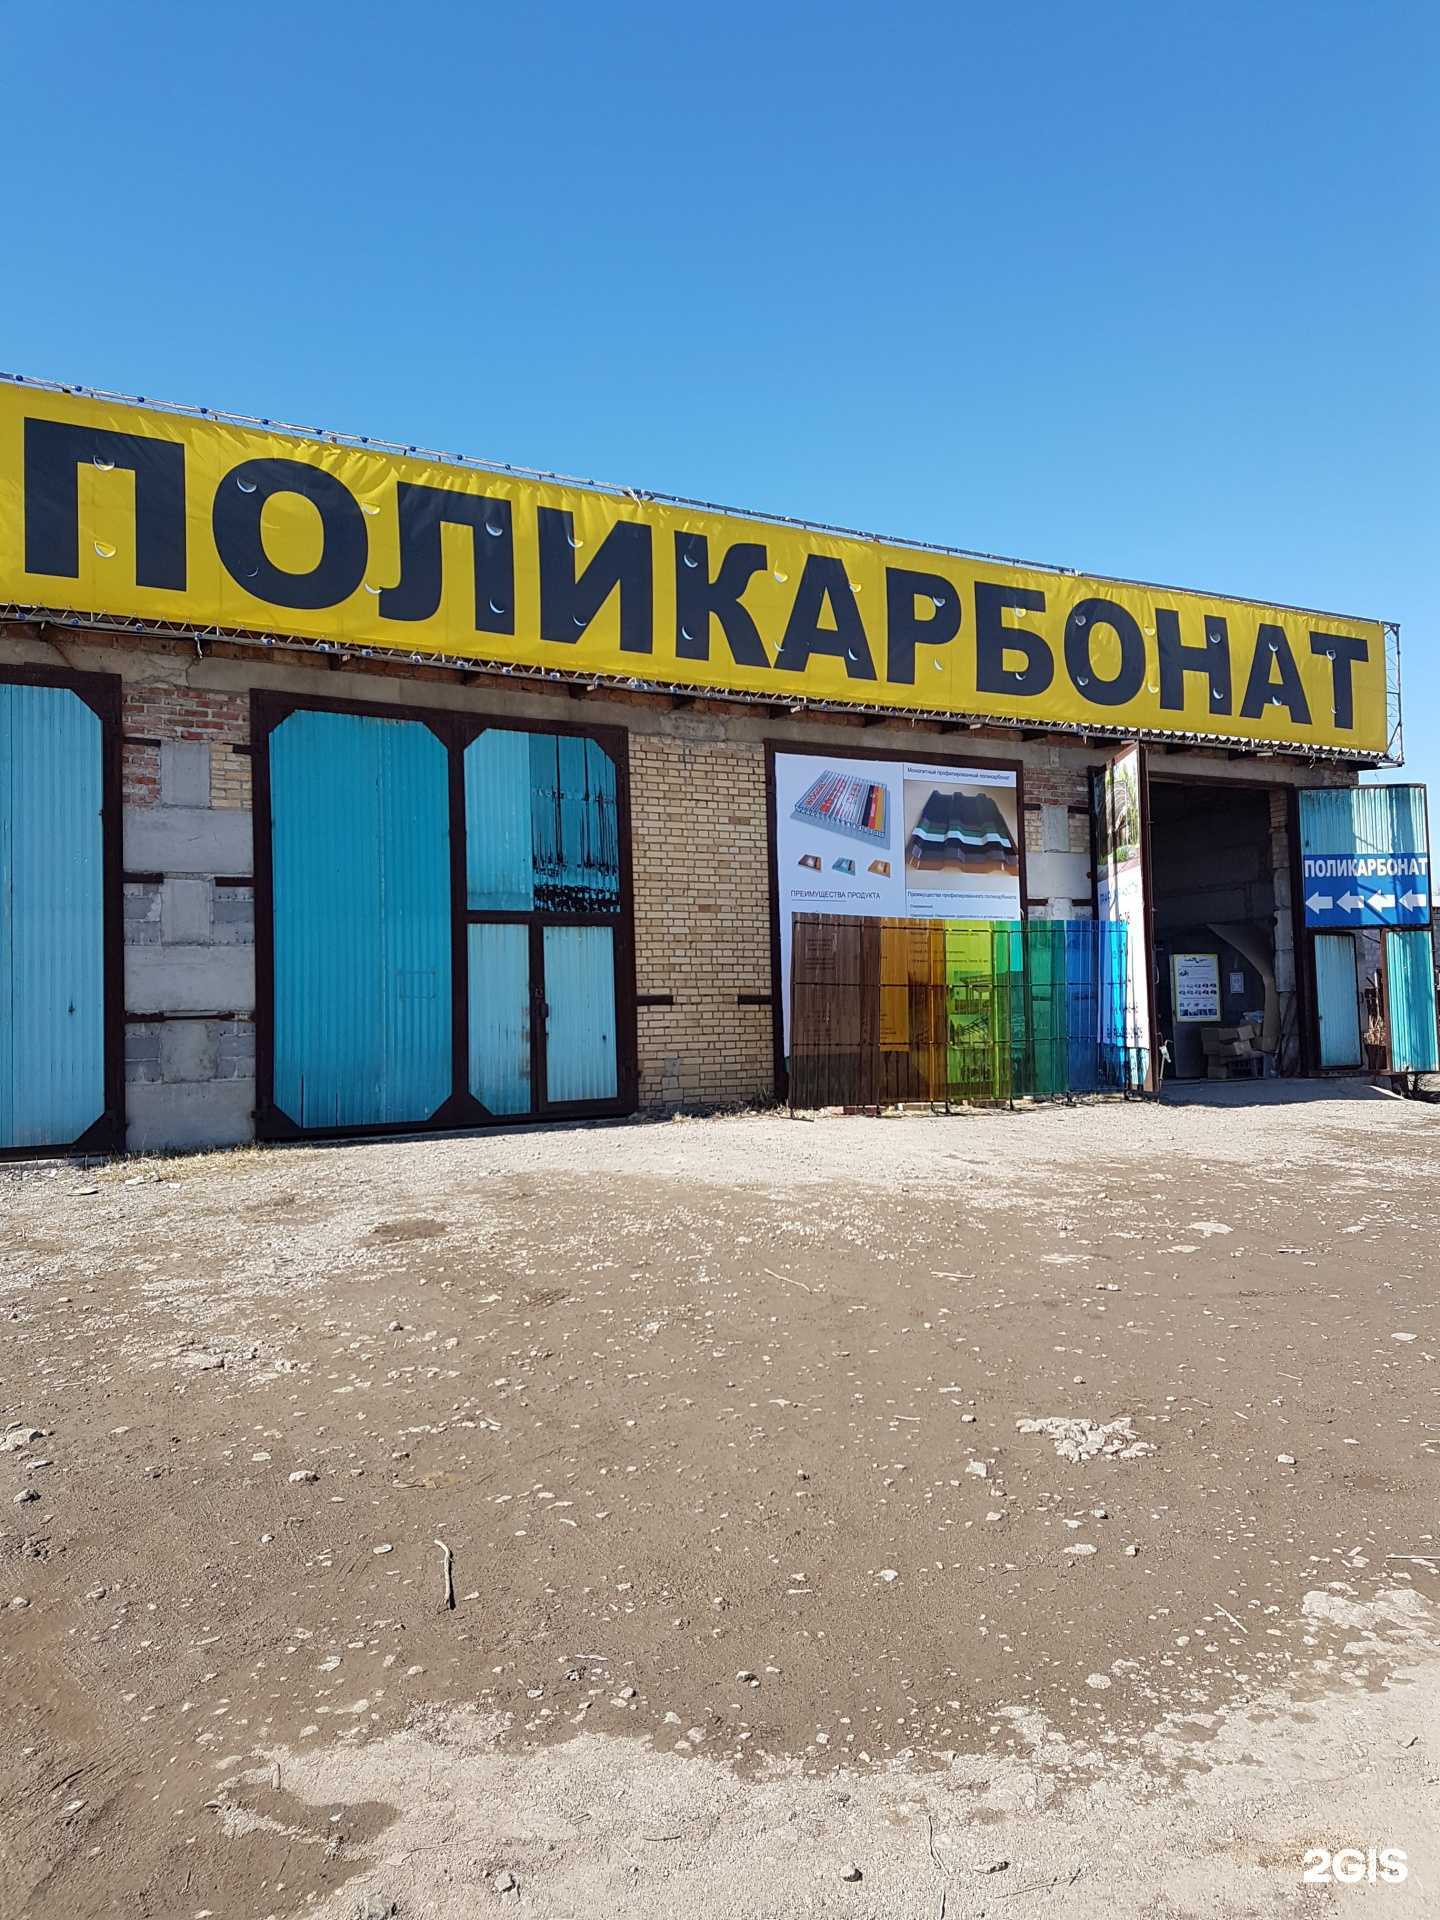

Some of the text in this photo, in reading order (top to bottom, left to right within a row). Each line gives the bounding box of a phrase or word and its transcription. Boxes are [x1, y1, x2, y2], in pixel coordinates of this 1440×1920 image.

[24, 417, 1369, 729] ПОЛИКАРБОНАТ
[1304, 858, 1428, 877] ПОЛИКАРБОНАТ
[791, 890, 881, 900] ПРЕИМУЩЕСТВА ПРОДУКТА
